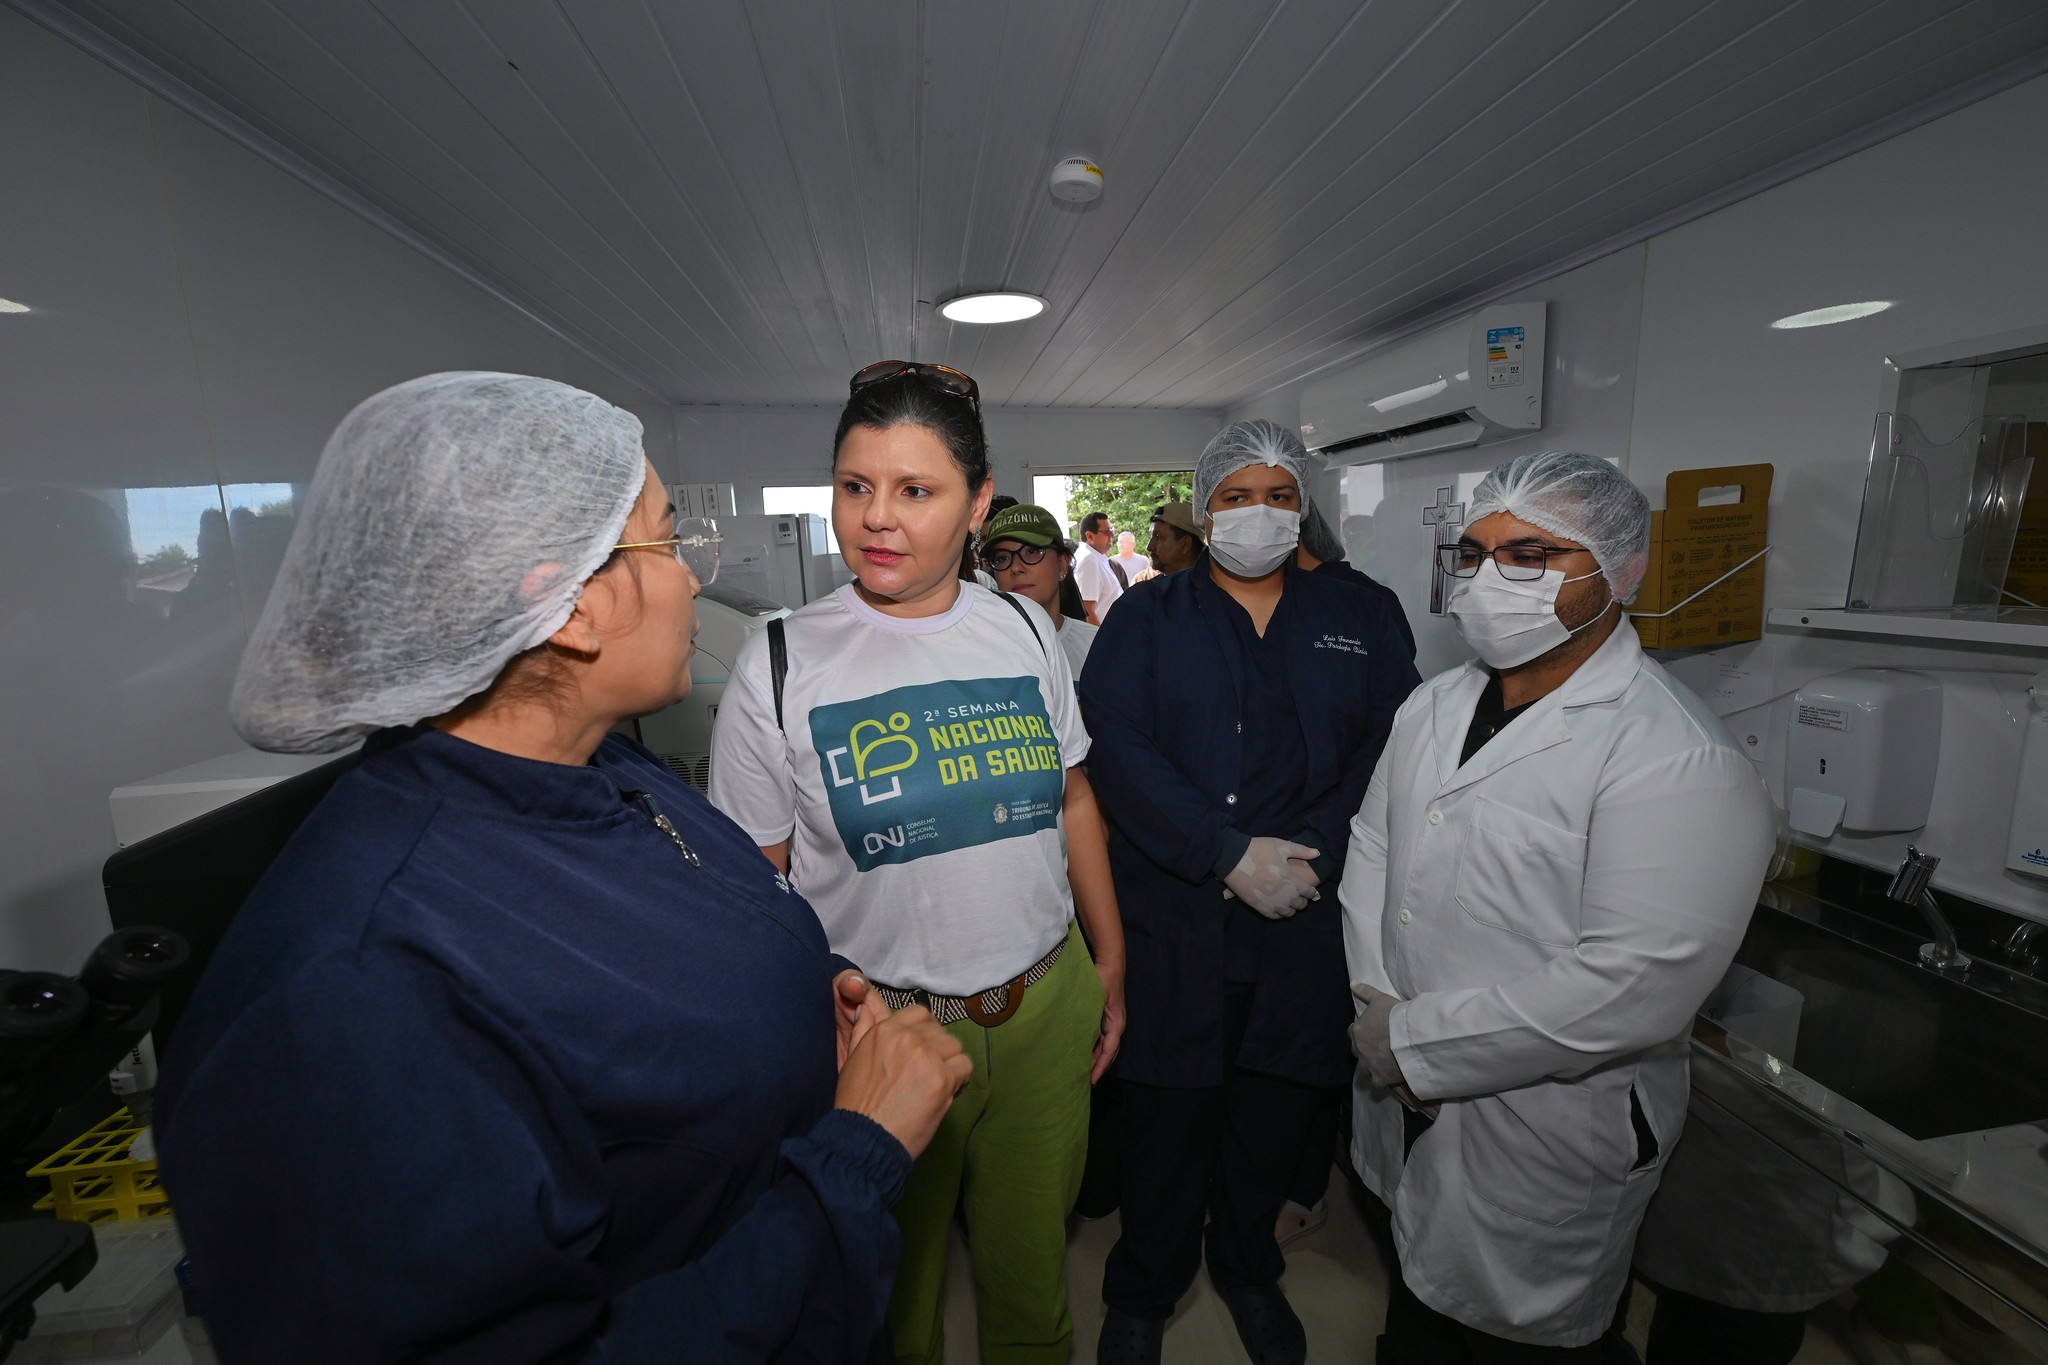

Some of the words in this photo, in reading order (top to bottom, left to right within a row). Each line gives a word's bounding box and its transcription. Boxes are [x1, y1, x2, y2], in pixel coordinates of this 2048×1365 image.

[947, 700, 1020, 718] SEMANA
[928, 715, 1052, 752] NACIONAL
[938, 755, 979, 786] DA
[986, 738, 1059, 776] SAÚDE
[906, 817, 936, 830] CONSELHO
[908, 825, 935, 837] NACIONAL
[863, 825, 905, 855] CNJ
[909, 837, 917, 845] DE
[917, 831, 939, 843] JUSTIÇA
